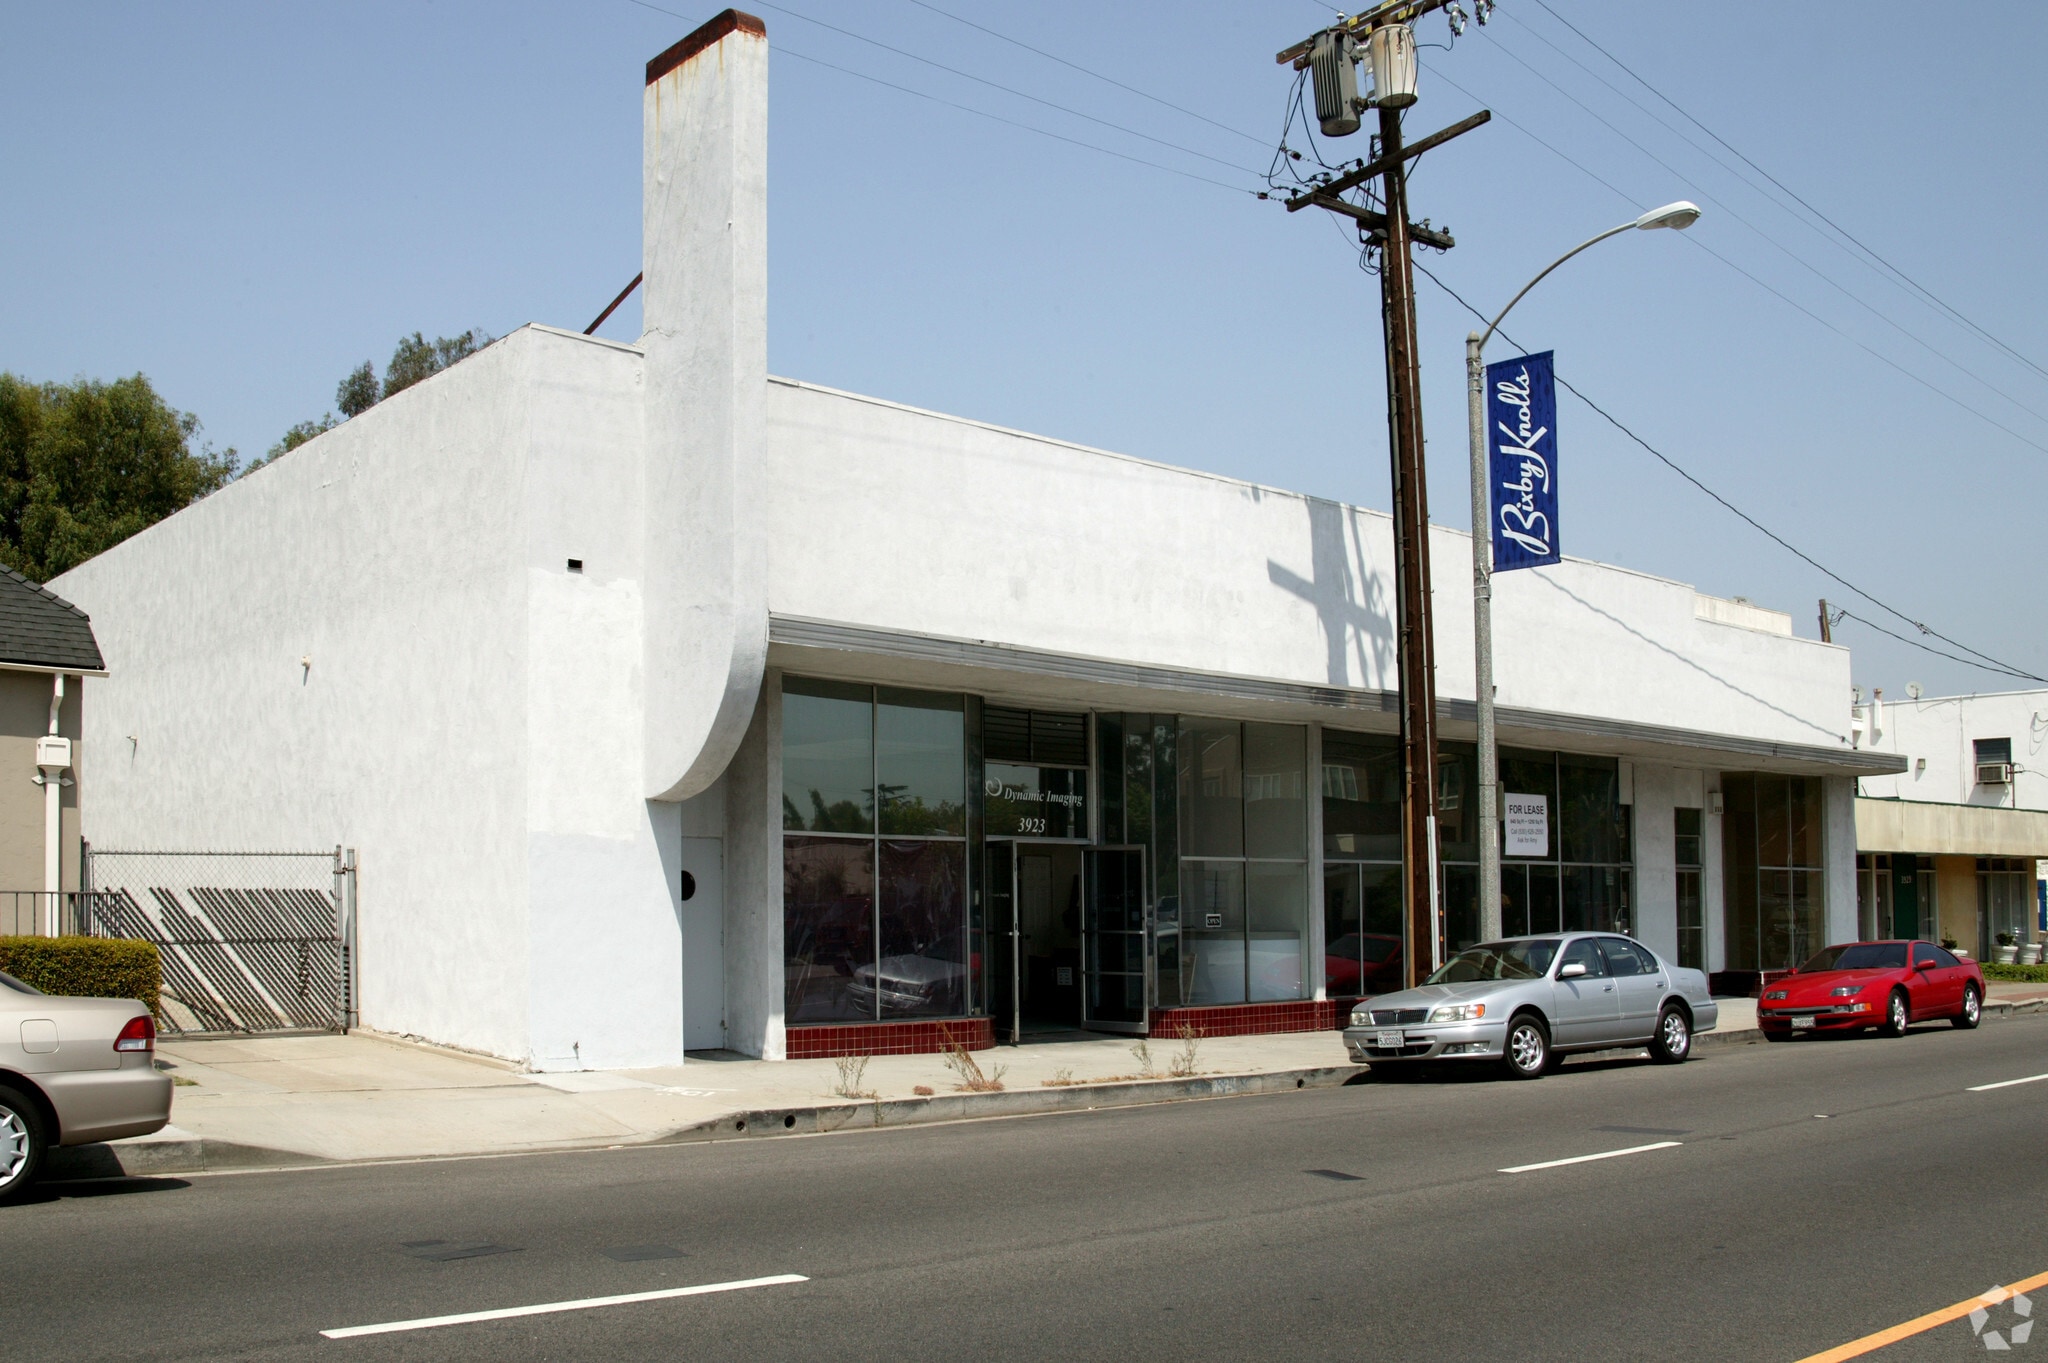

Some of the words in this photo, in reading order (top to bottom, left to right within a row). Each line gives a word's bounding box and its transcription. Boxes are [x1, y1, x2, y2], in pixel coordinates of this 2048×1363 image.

[1497, 365, 1550, 494] Knolls
[1500, 459, 1550, 555] Bixby
[1004, 787, 1044, 803] Dynamic
[1046, 790, 1083, 807] Imaging
[1509, 805, 1522, 814] FOR
[1524, 805, 1544, 815] LEASE
[1017, 817, 1046, 833] 3923
